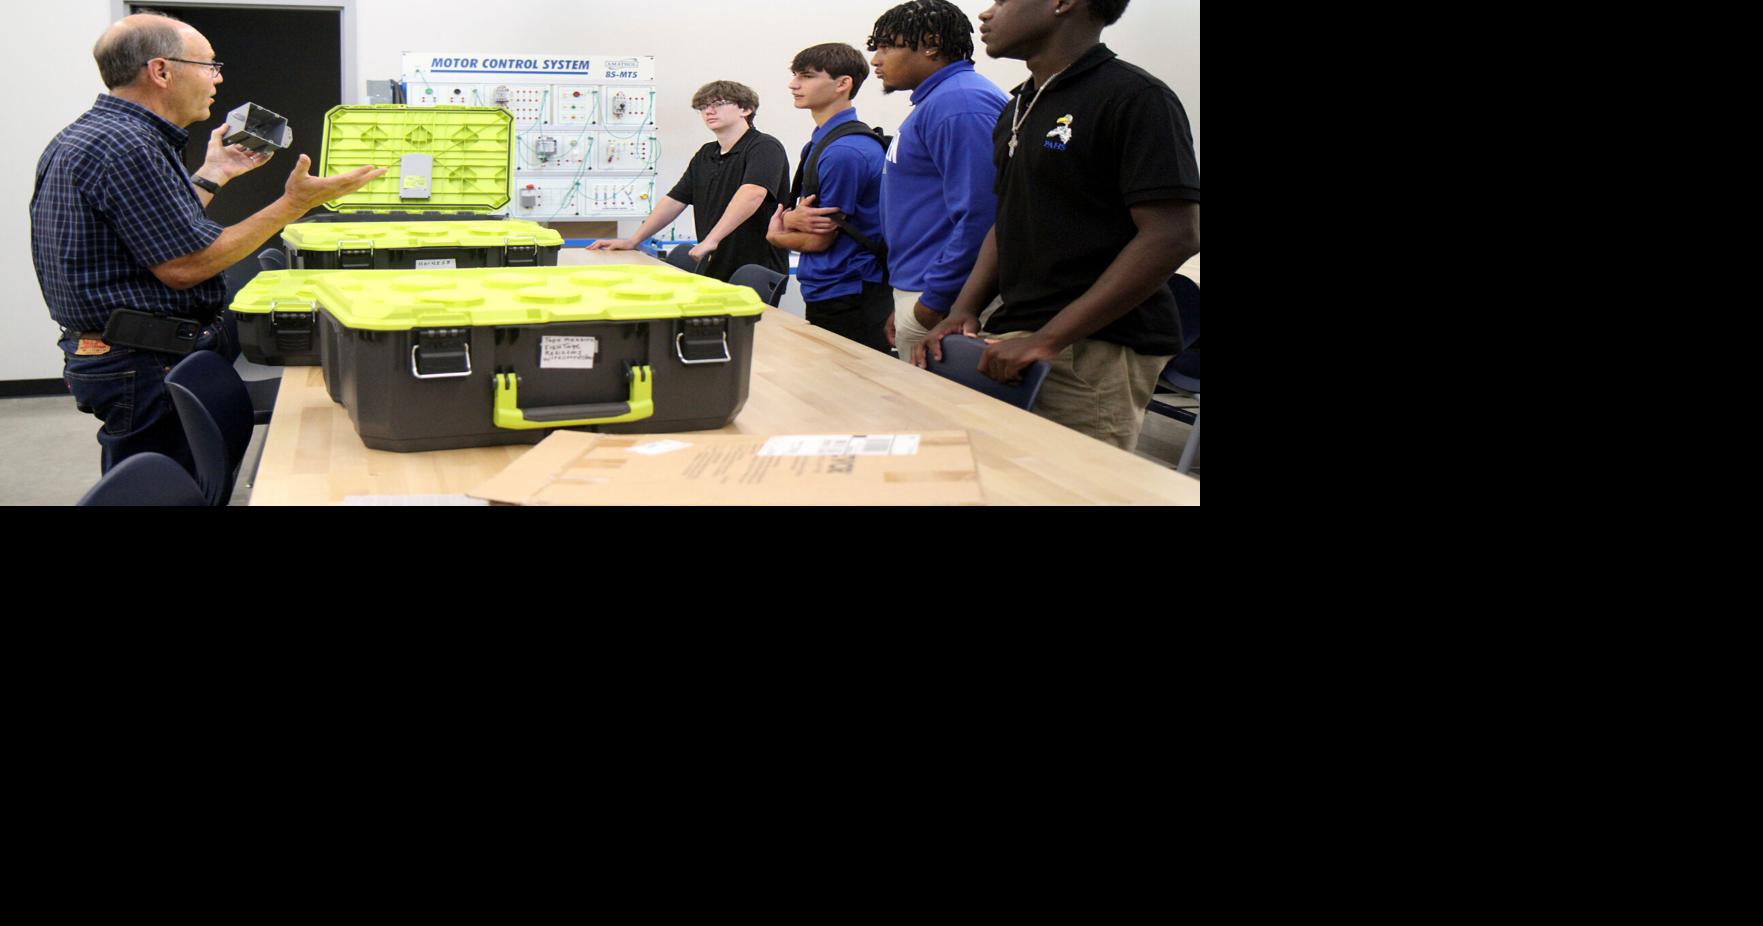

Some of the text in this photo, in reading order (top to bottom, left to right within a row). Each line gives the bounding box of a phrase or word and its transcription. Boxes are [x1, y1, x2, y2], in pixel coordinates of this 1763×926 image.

[431, 58, 590, 70] MOTOR CONTROL SYSTEM
